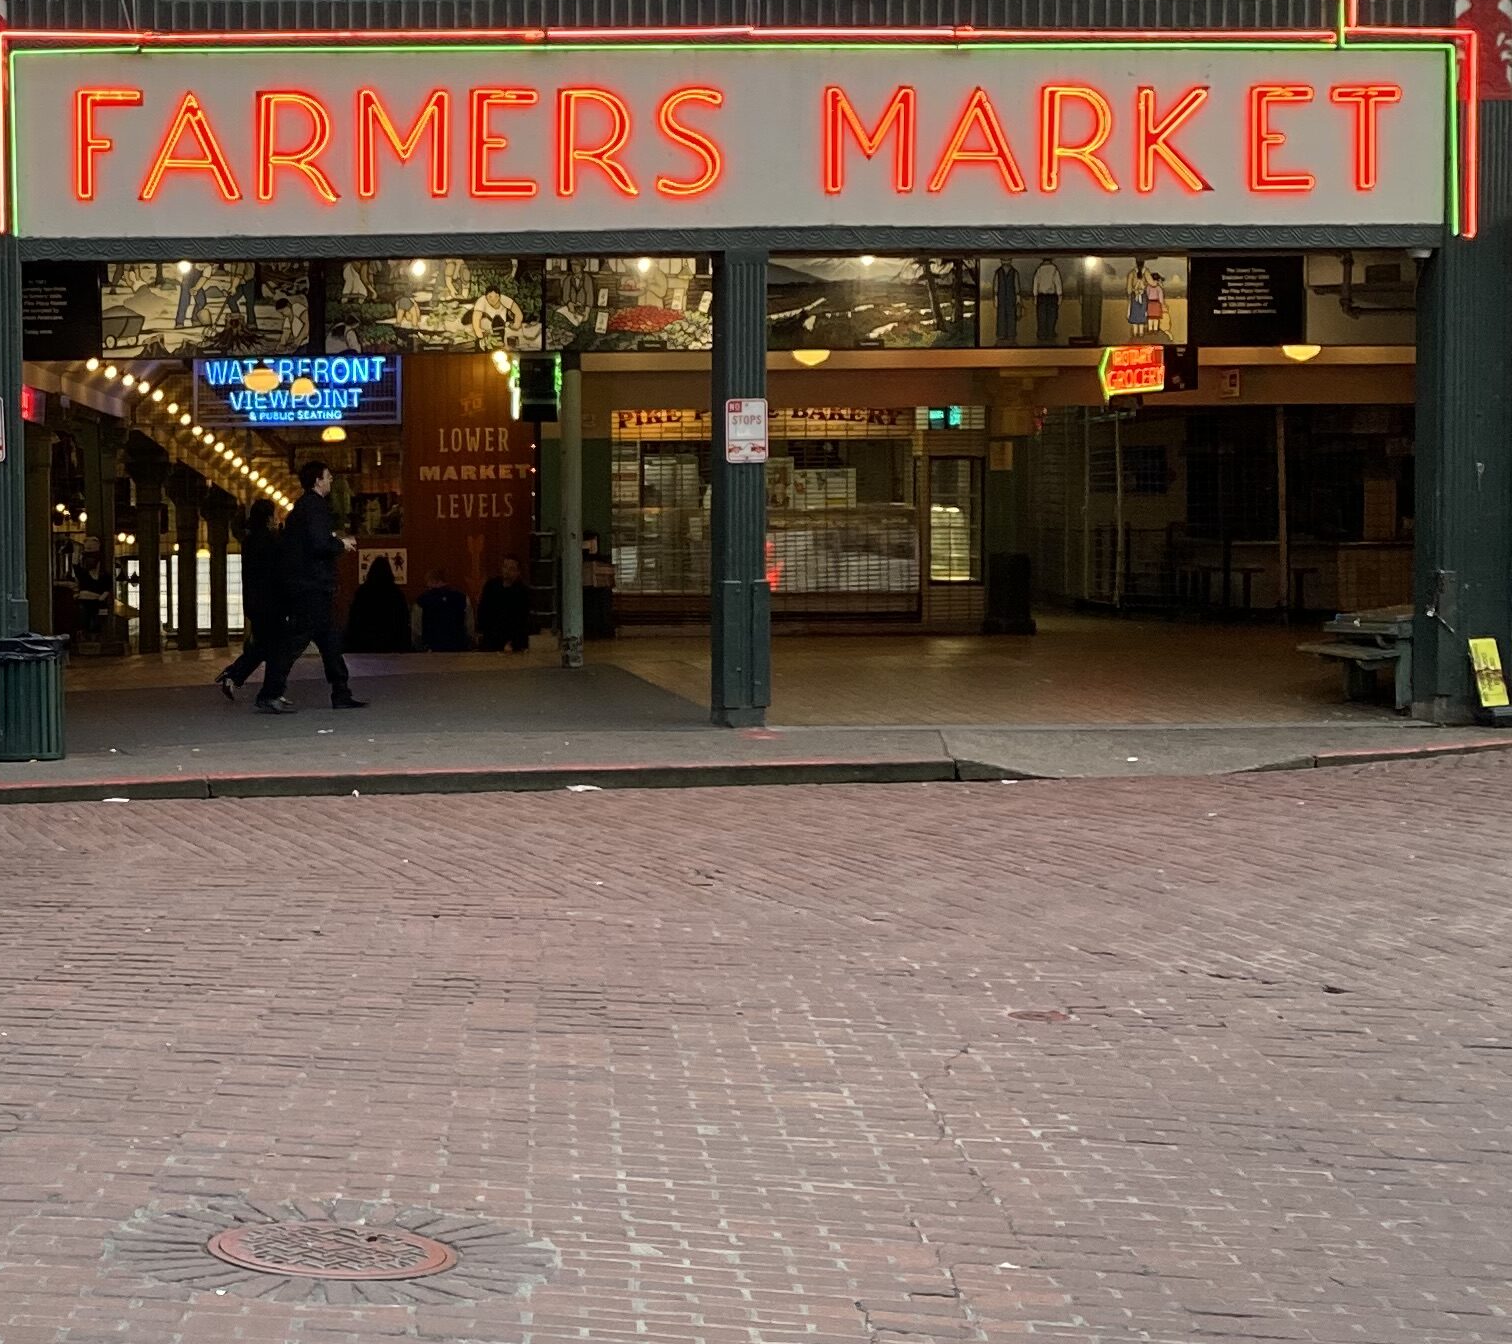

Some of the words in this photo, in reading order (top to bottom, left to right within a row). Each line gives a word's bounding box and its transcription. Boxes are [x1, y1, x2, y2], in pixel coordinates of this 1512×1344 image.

[73, 86, 724, 203] FARMERS
[823, 84, 1403, 194] MARKET
[205, 356, 386, 385] WATRFRONT
[229, 387, 363, 411] VIEWPOINT
[729, 402, 740, 412] NO
[259, 411, 295, 421] PUBLIC
[297, 410, 342, 420] SEATING
[731, 415, 762, 425] STOPS
[437, 427, 510, 453] LOWER
[419, 464, 530, 481] MARKET
[435, 493, 514, 519] LEVELS
